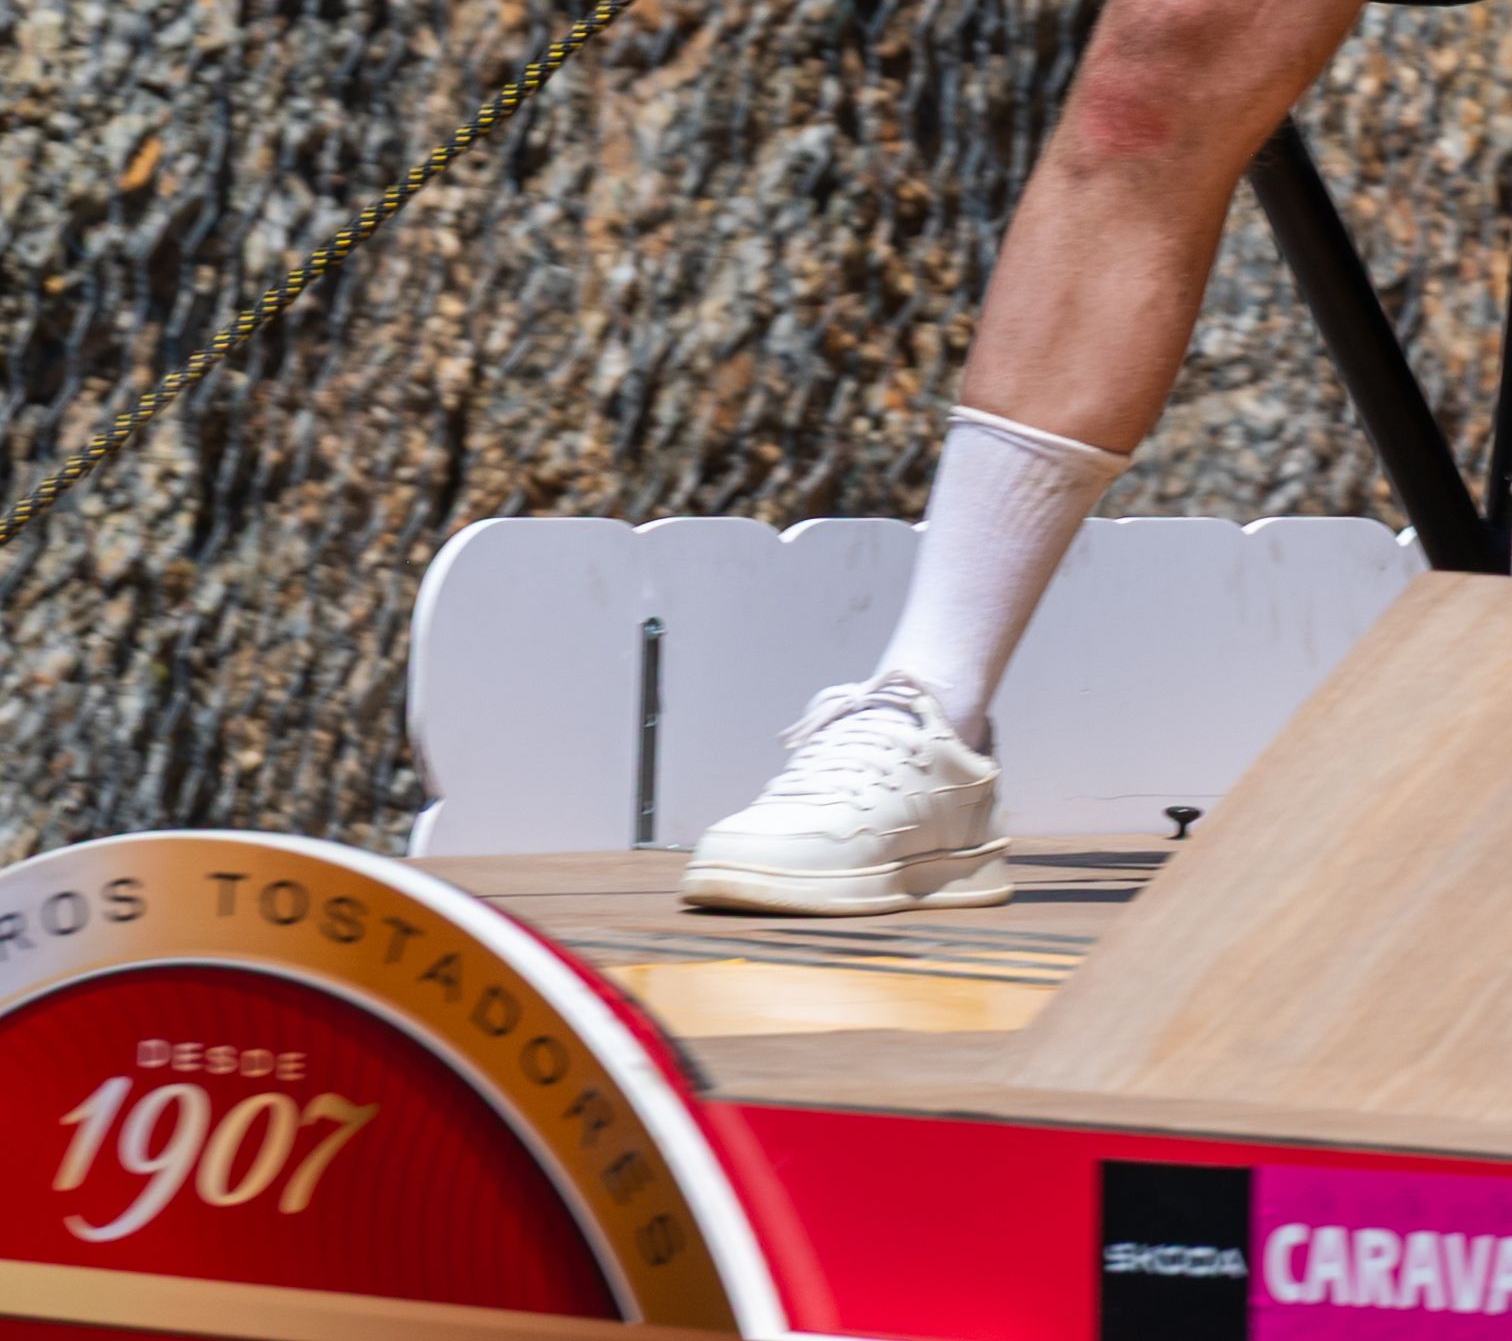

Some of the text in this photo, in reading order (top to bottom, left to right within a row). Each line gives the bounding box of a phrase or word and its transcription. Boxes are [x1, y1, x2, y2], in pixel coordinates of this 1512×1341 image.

[0, 872, 686, 1267] ROS TOSTADORES
[136, 1038, 307, 1081] DESDE
[52, 1075, 381, 1243] 1907
